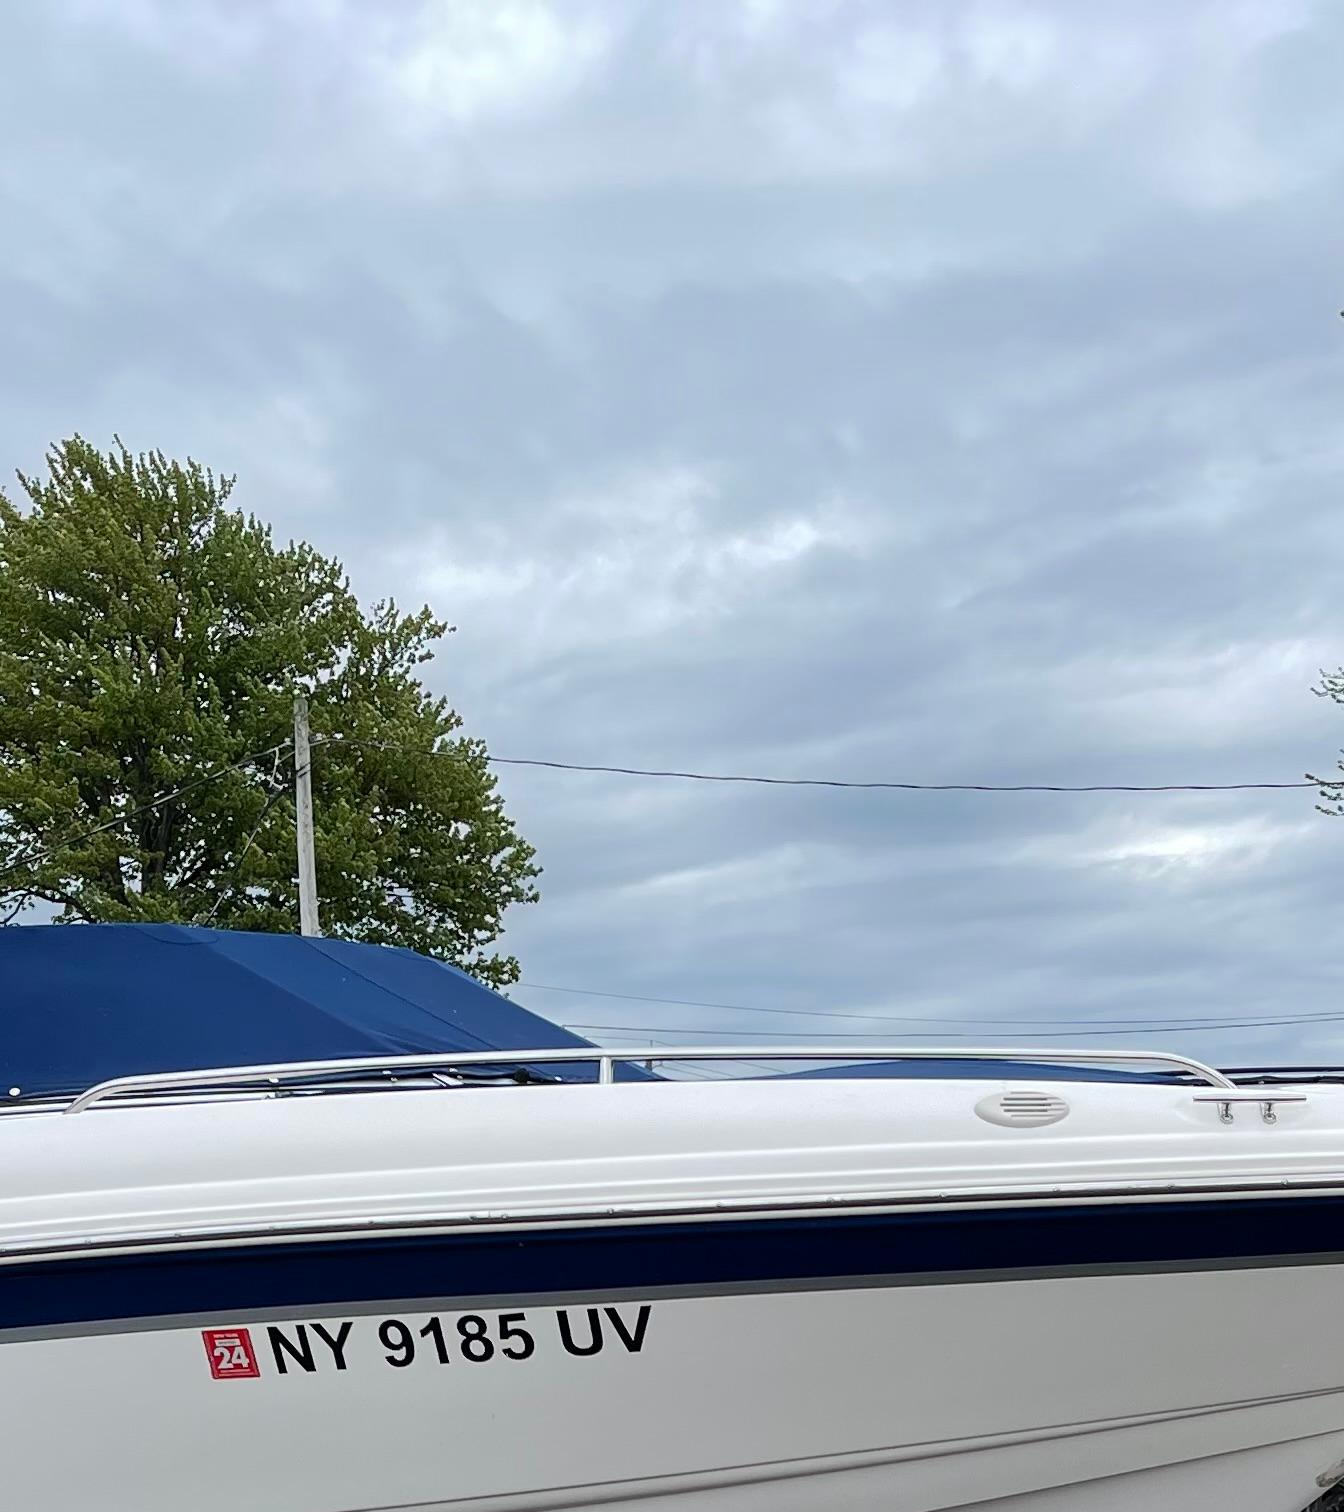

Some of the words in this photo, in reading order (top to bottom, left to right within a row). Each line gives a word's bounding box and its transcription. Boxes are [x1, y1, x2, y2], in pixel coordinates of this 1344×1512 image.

[213, 1345, 250, 1369] 24
[266, 1320, 354, 1375] NY
[377, 1311, 536, 1368] 9185
[555, 1304, 652, 1357] UV
